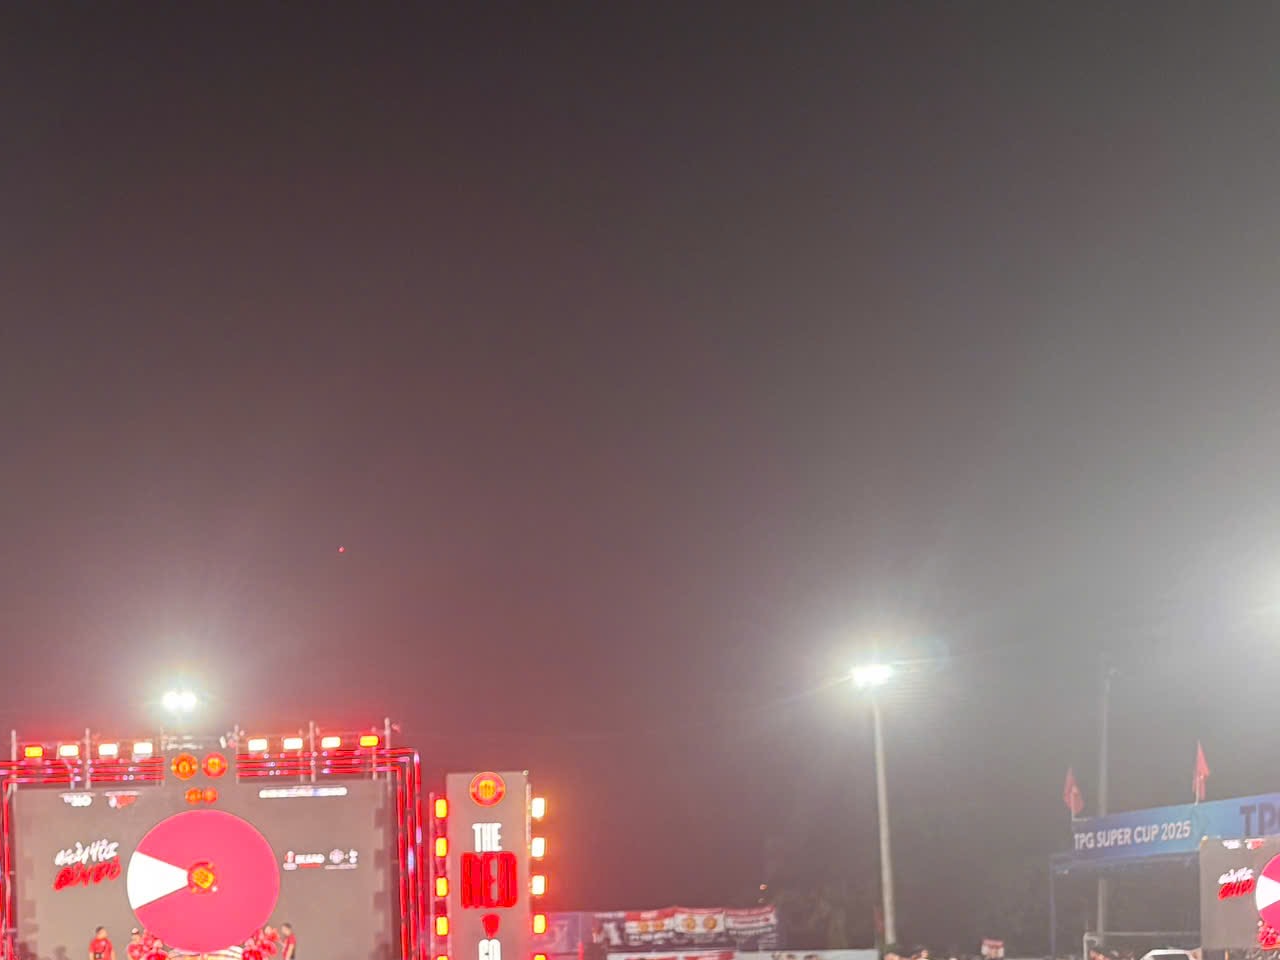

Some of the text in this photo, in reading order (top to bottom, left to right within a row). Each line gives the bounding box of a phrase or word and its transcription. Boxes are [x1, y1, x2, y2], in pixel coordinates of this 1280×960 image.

[472, 822, 503, 852] THE
[1074, 820, 1191, 850] TPG SUPER CUP 2025
[460, 851, 518, 910] RED
